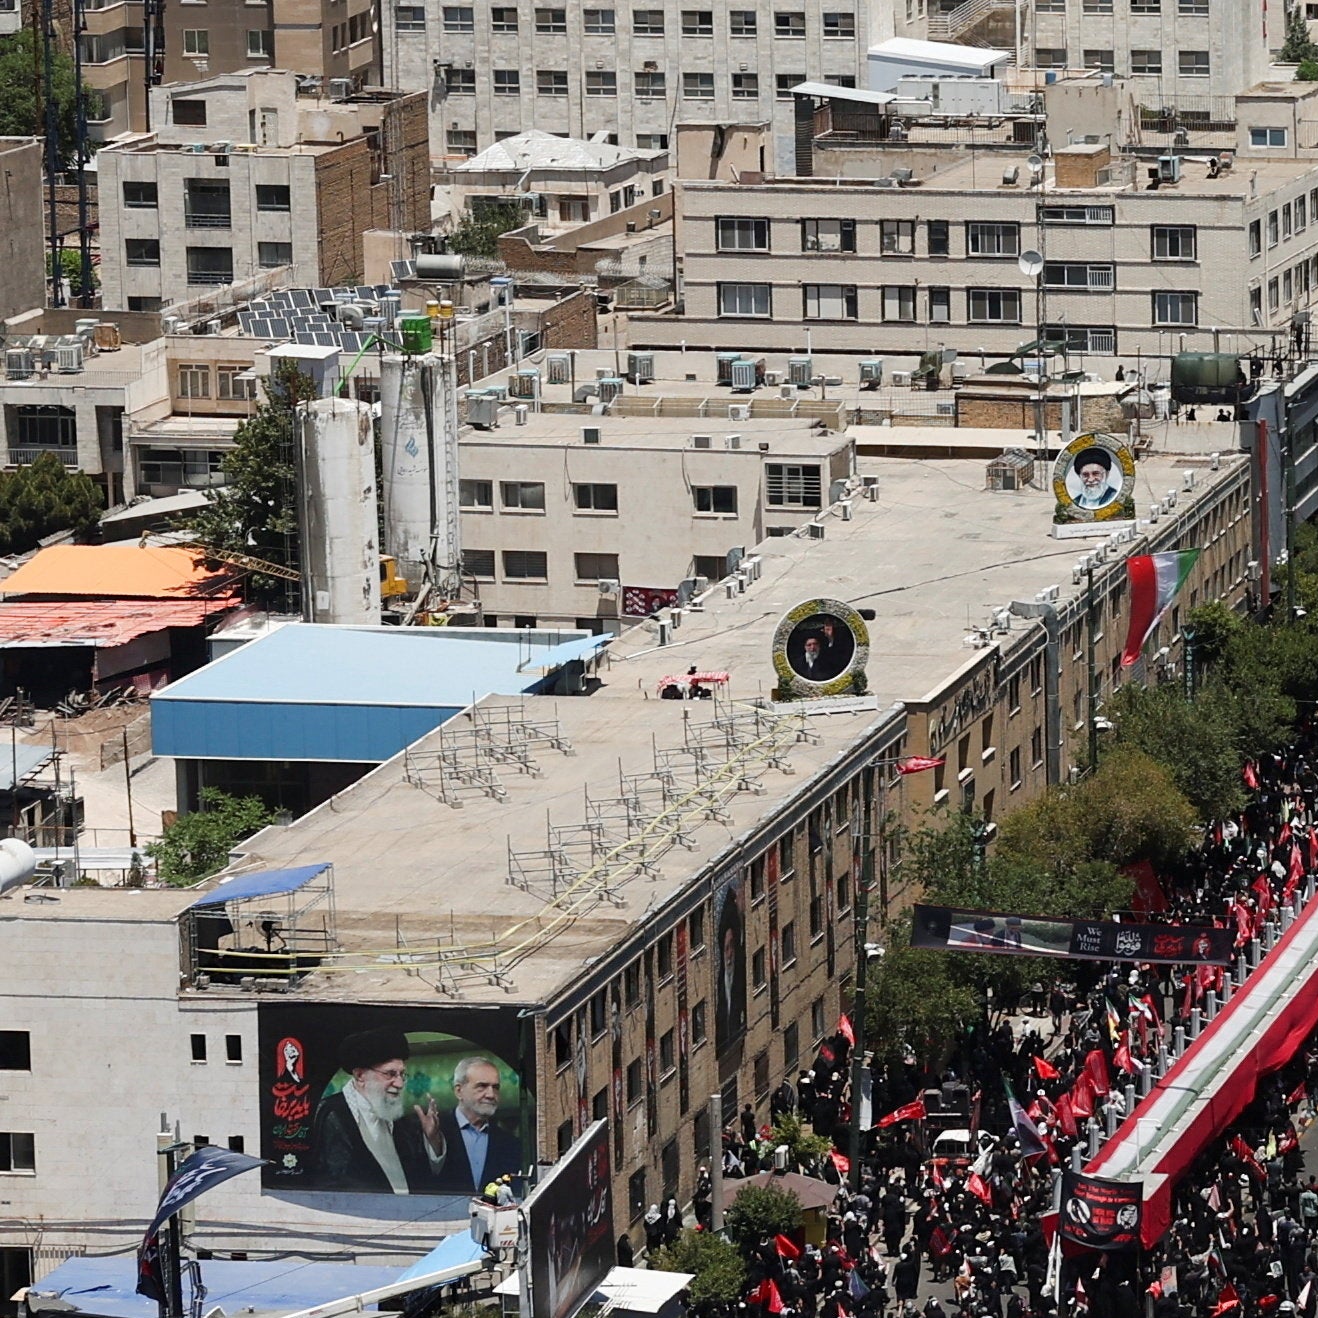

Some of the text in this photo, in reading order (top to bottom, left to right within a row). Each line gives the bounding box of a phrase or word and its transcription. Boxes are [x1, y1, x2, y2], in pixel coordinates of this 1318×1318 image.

[1087, 926, 1102, 936] We
[1077, 934, 1101, 945] Must
[1080, 943, 1100, 953] Rise
